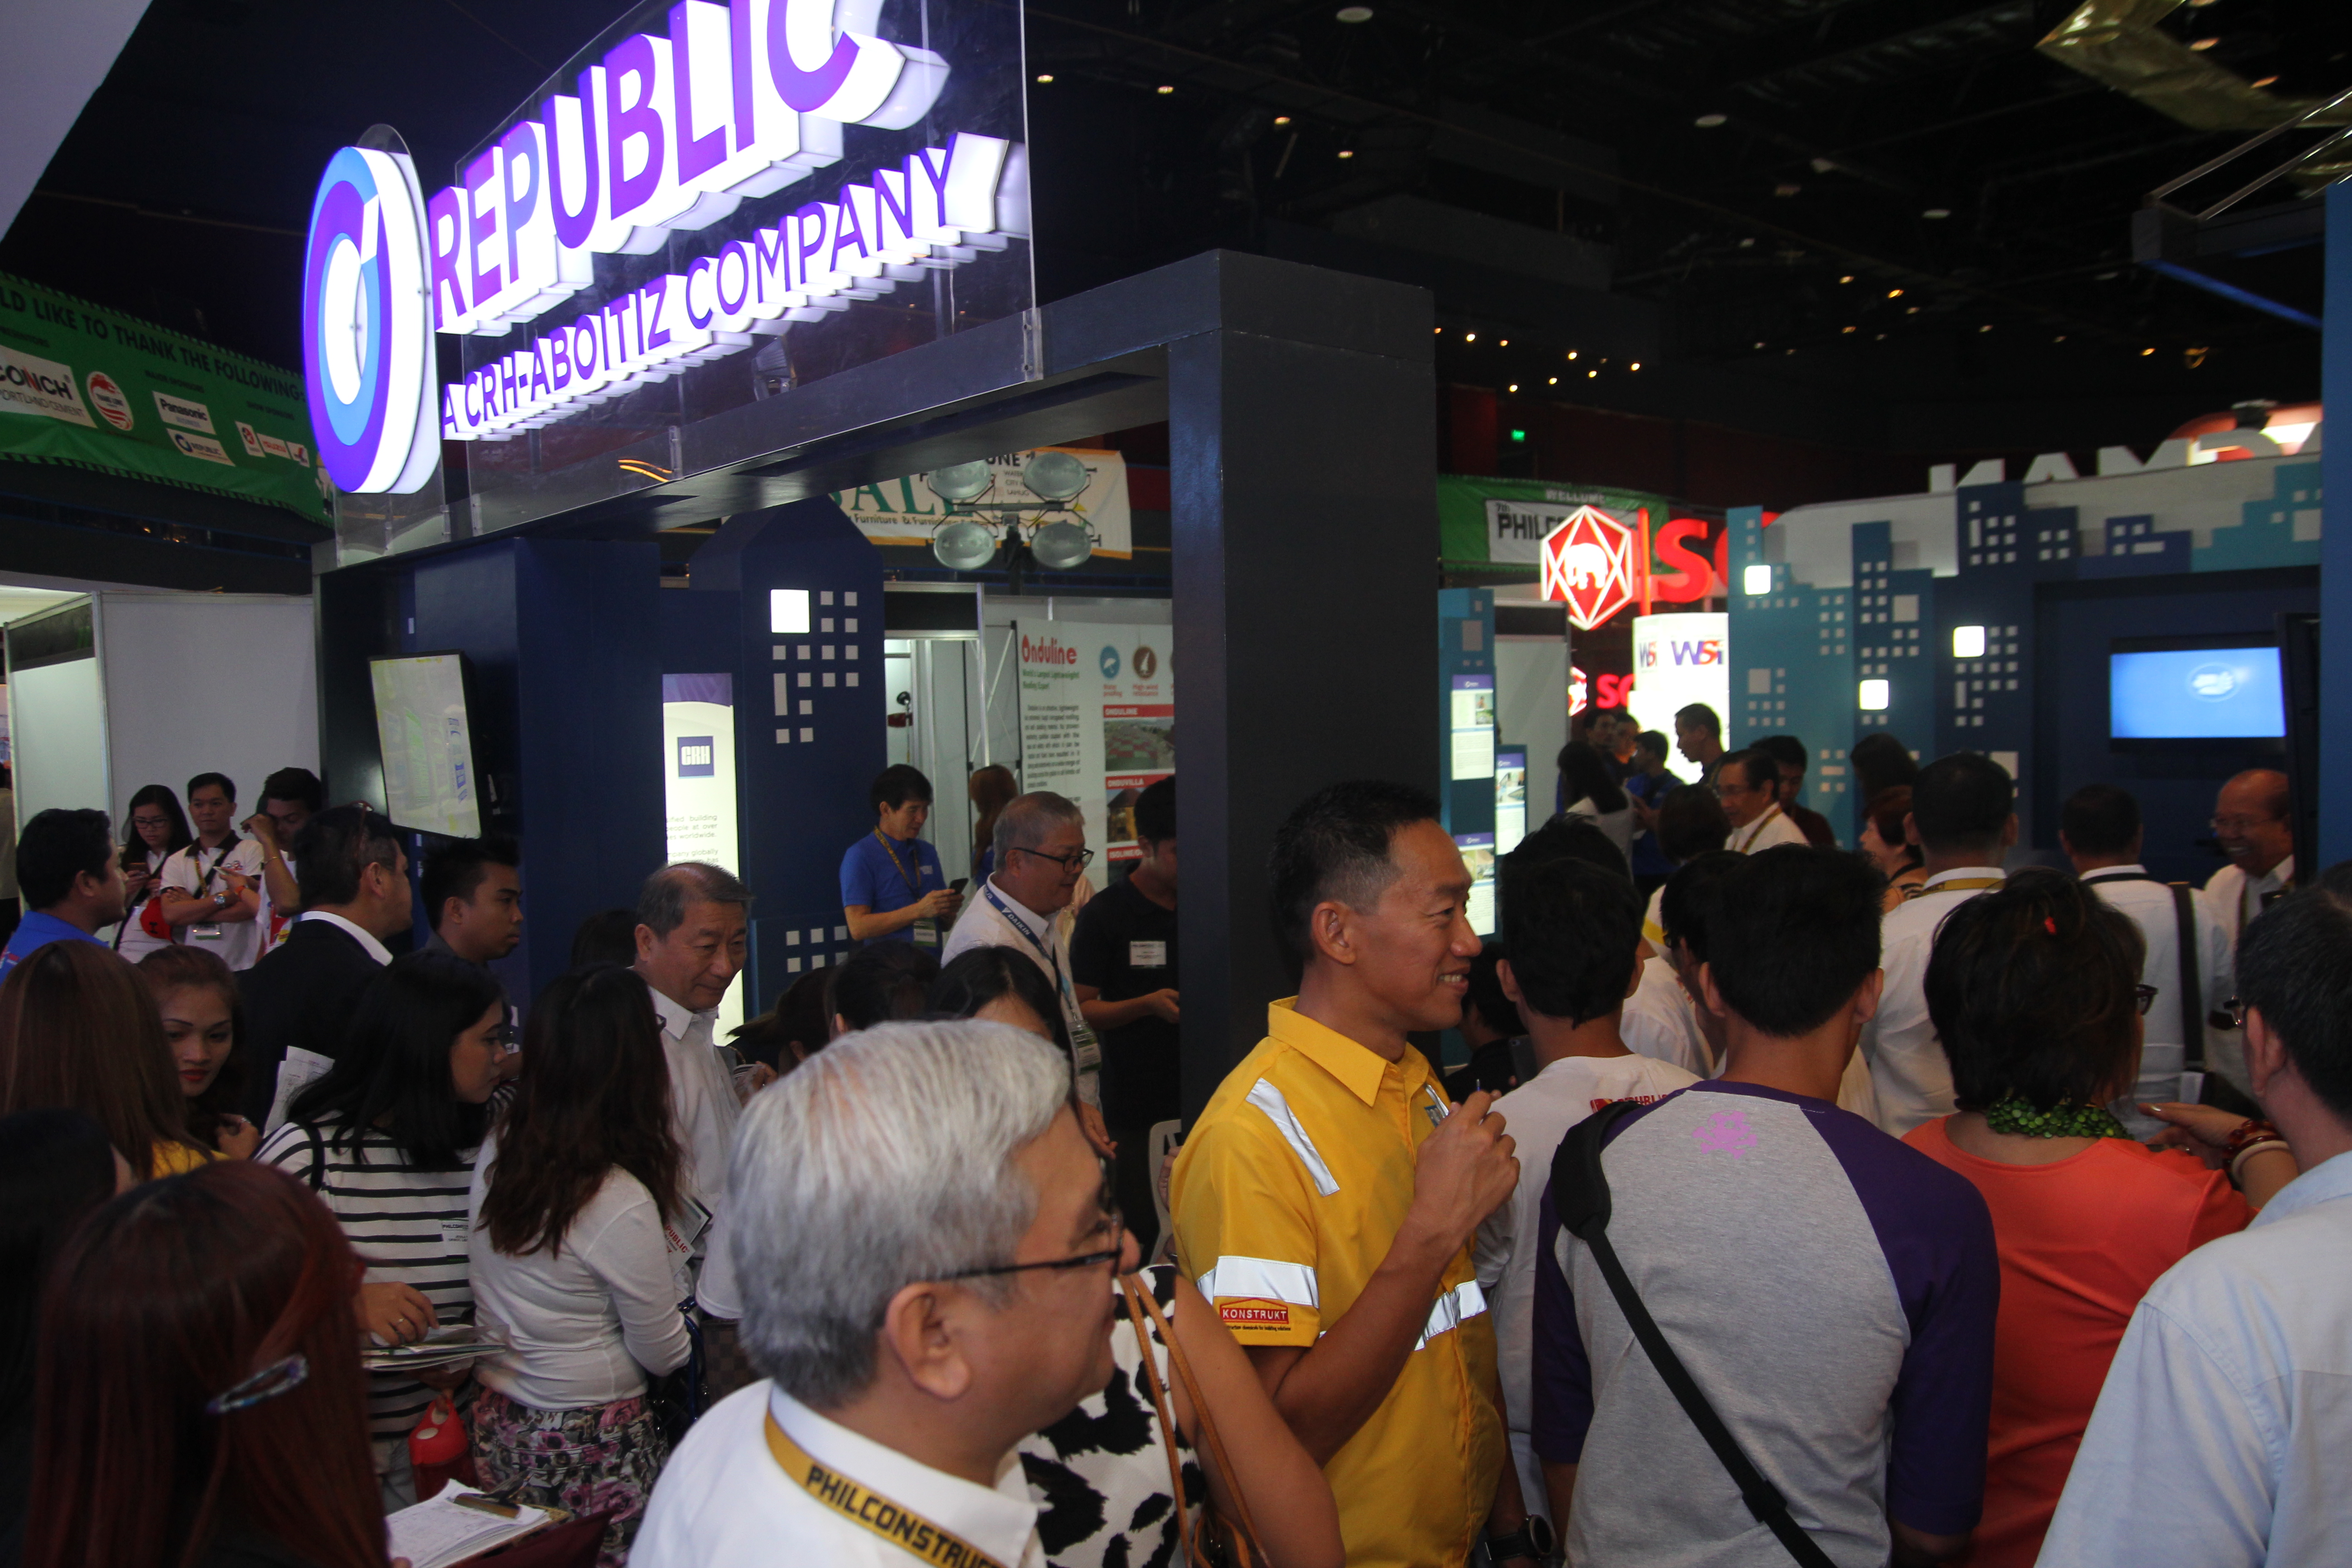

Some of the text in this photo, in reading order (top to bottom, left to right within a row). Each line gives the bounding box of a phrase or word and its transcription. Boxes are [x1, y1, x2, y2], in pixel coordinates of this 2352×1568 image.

[428, 0, 860, 333] REPUBLIC
[442, 132, 957, 434] A CRH-ABOITIZ COMPANY
[33, 298, 78, 330] LIKE
[81, 313, 108, 339] TO
[113, 324, 178, 363] THANK
[179, 346, 211, 372] THE
[160, 398, 207, 421] Panasonic
[854, 513, 897, 524] Furniture
[681, 745, 711, 765] CRH
[691, 848, 719, 857] globally
[1007, 913, 1031, 936] DAIKIN
[1222, 1309, 1287, 1320] KONSTRUKT
